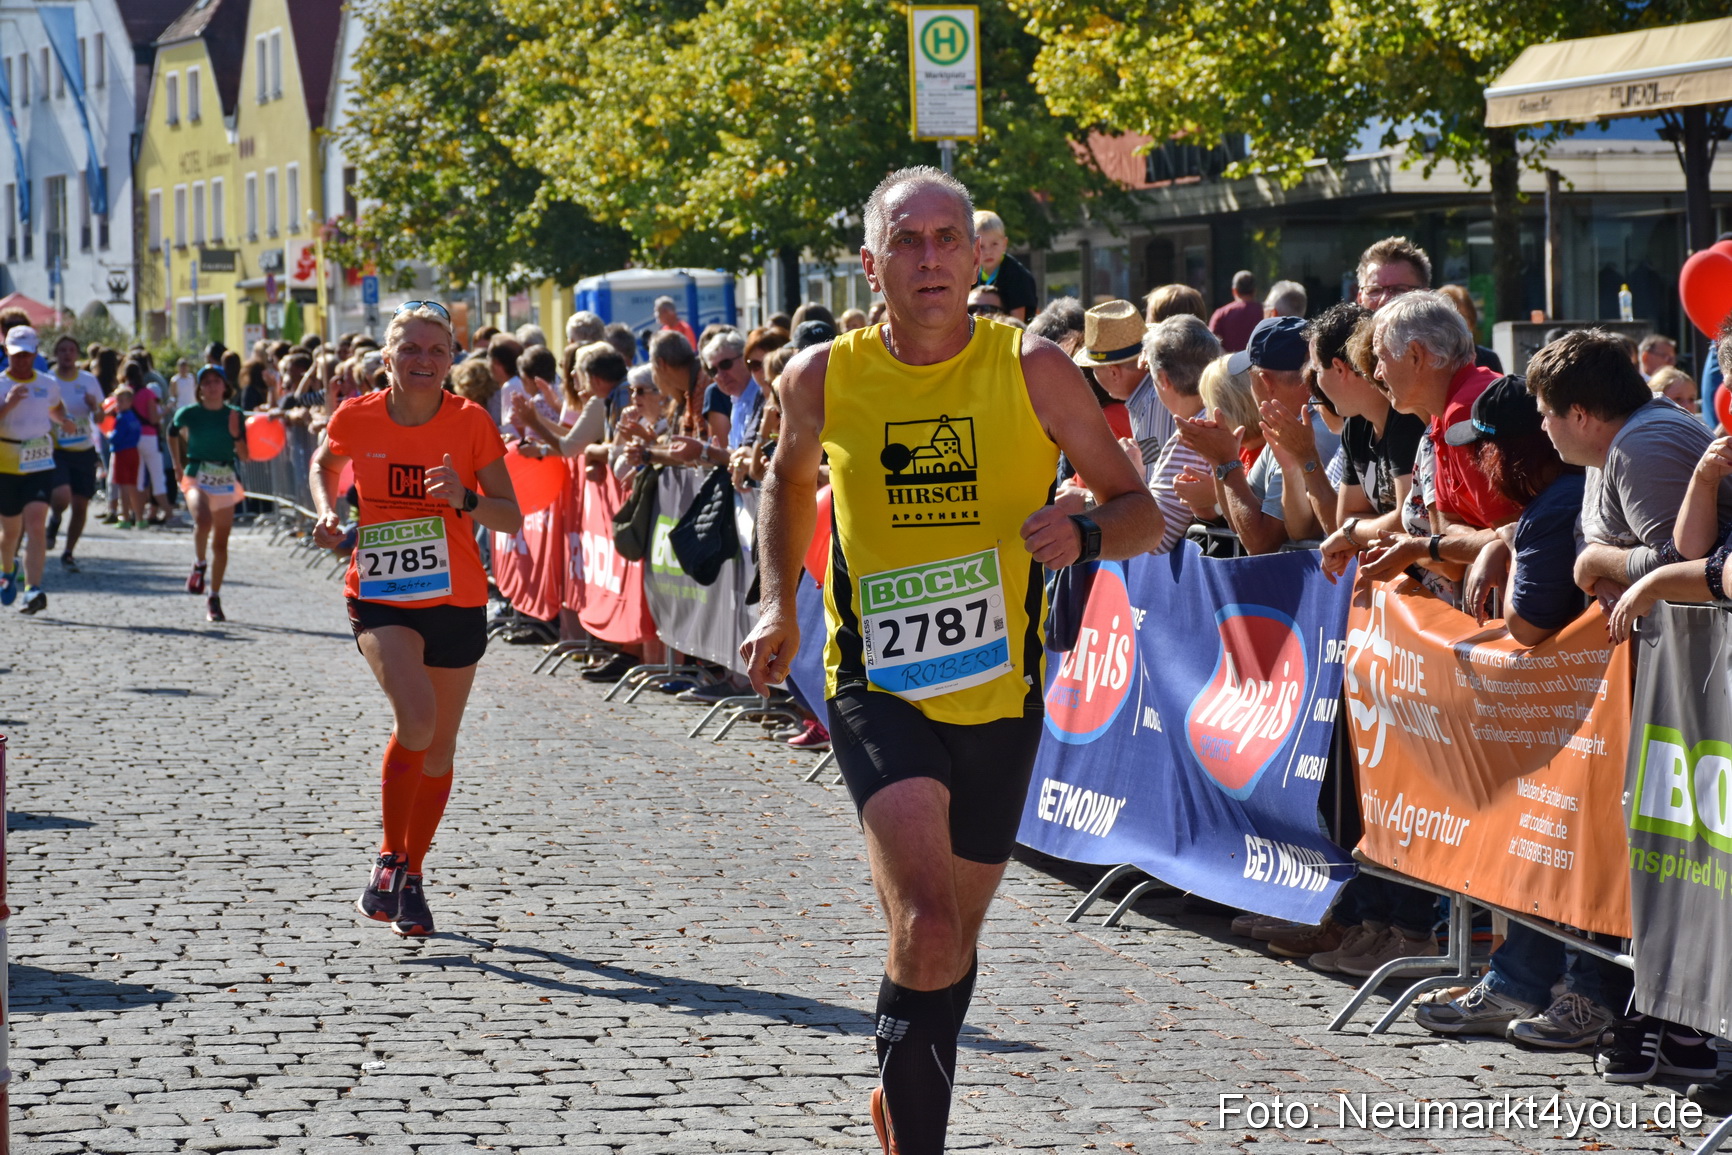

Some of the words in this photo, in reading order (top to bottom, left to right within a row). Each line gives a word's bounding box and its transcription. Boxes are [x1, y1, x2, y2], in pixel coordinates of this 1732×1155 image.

[933, 27, 956, 54] H
[924, 72, 966, 80] Marktplatz
[391, 466, 423, 497] D&H
[886, 484, 978, 505] HIRSCH
[892, 510, 979, 521] APOTHEKE
[363, 520, 438, 547] BOCK
[365, 545, 438, 576] 2785
[868, 557, 991, 610] BOCK
[879, 598, 988, 659] 2787
[901, 644, 1005, 689] ROBERT
[1392, 645, 1427, 696] CODE
[1459, 650, 1502, 668] Neumarkts
[1504, 653, 1558, 670] moderner
[1558, 648, 1610, 666] Partner
[1050, 685, 1081, 709] SPORTS
[1455, 667, 1467, 687] für
[1468, 671, 1481, 689] die
[1481, 674, 1541, 700] Konzeption
[1540, 675, 1568, 693] und
[1196, 652, 1299, 754] hervis
[1474, 698, 1498, 717] Ihrer
[1498, 702, 1551, 723] Projekte
[1550, 705, 1574, 719] was
[1390, 693, 1451, 744] CLINIC
[1200, 734, 1234, 762] SPORTS
[1470, 722, 1536, 748] Grafikdesign
[1538, 726, 1557, 745] und
[1517, 777, 1540, 800] Melden
[1387, 792, 1470, 847] Agentur
[1243, 834, 1274, 882] GET
[1553, 848, 1574, 870] 897
[1714, 858, 1727, 899] by
[876, 1029, 904, 1042] cep
